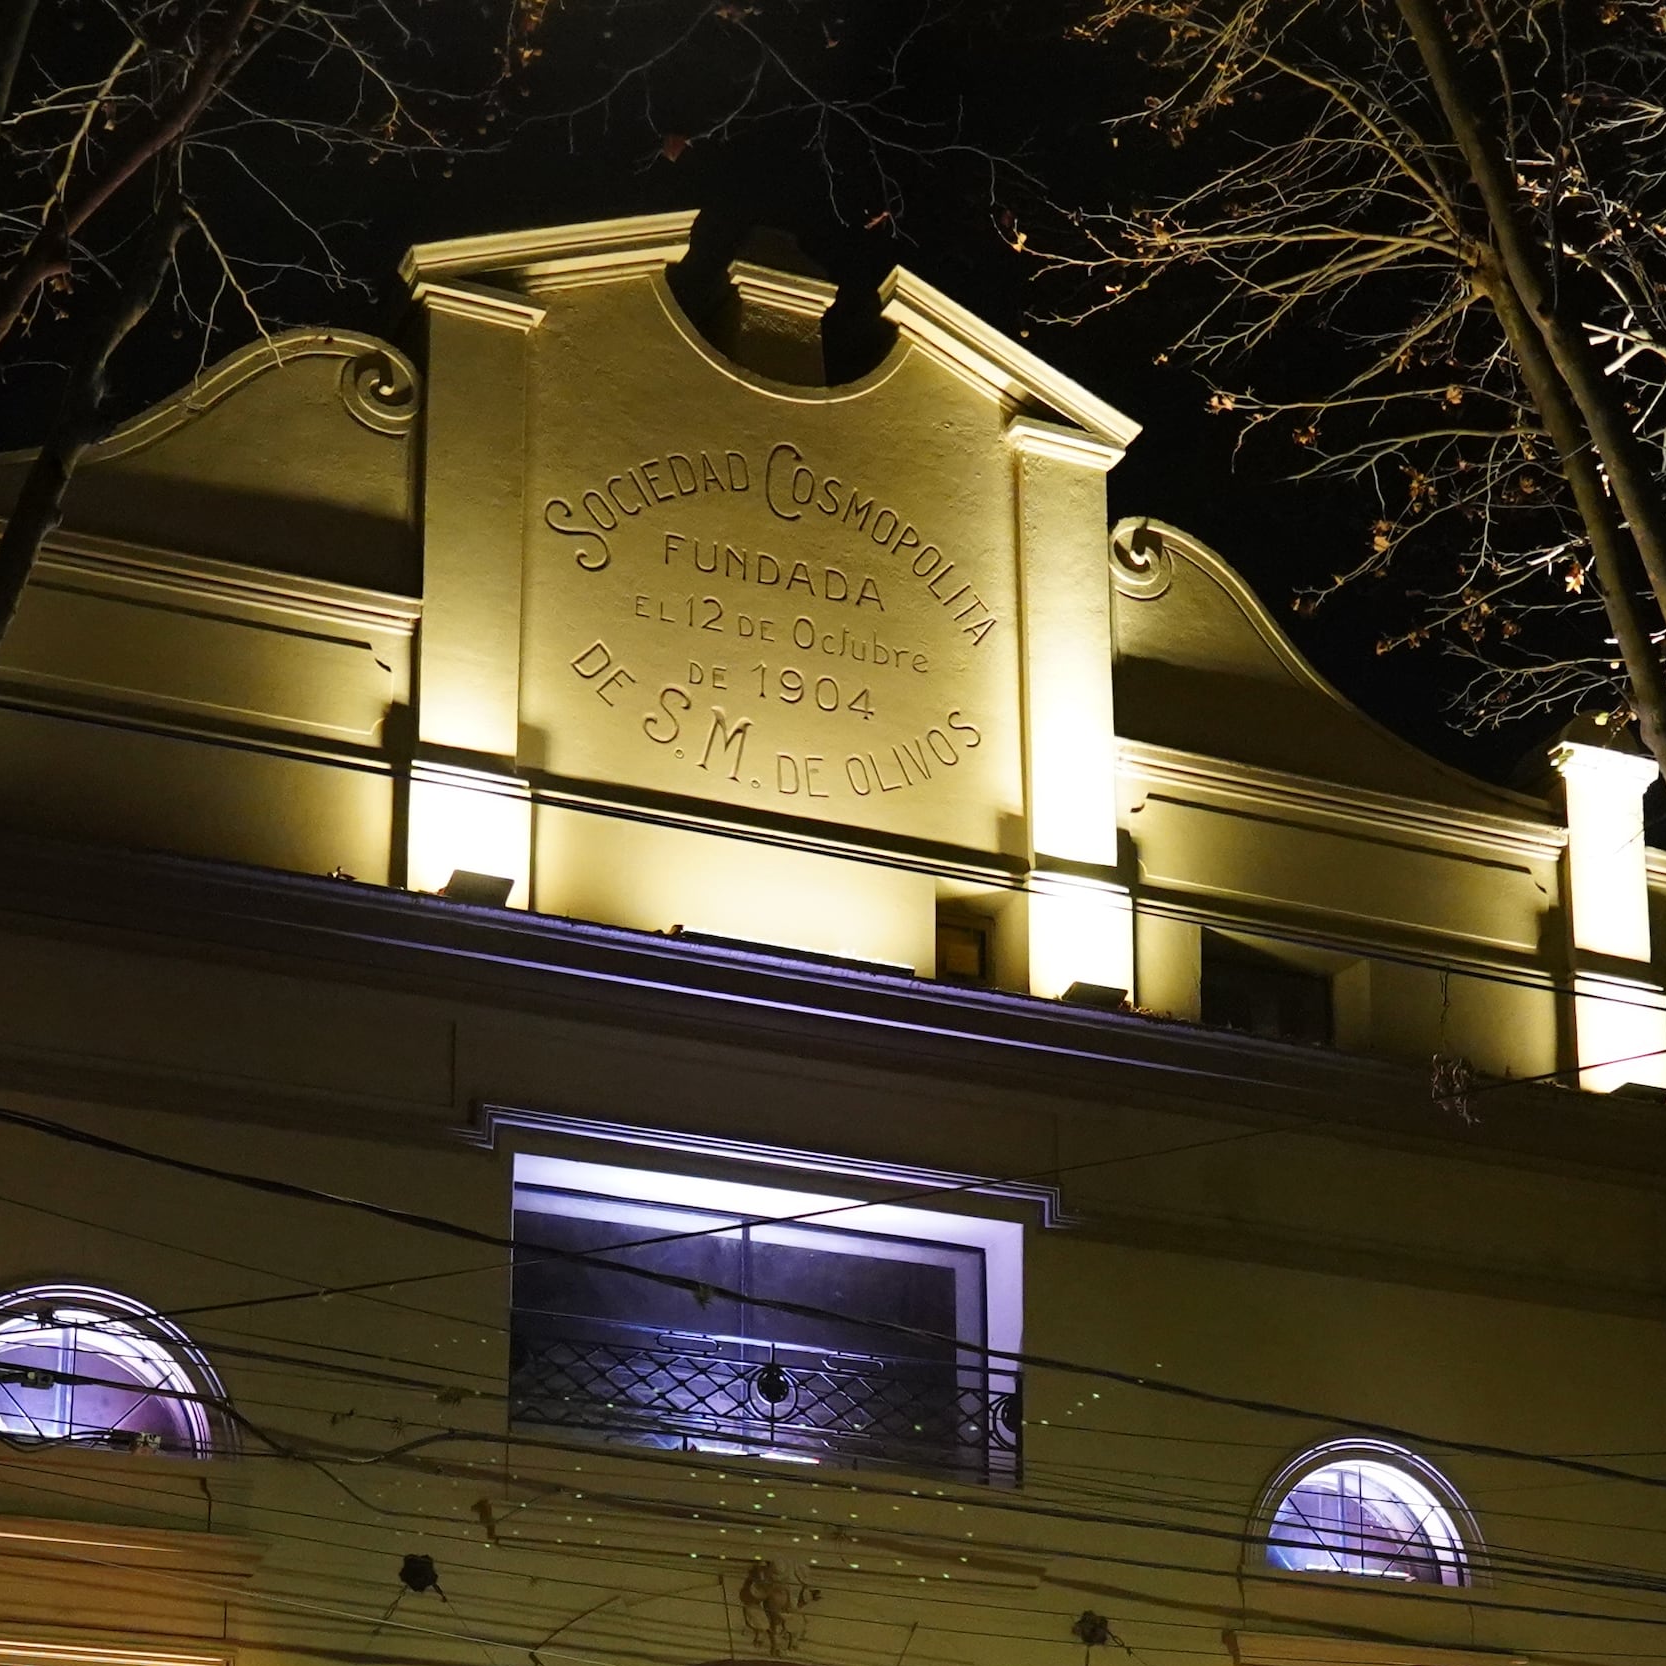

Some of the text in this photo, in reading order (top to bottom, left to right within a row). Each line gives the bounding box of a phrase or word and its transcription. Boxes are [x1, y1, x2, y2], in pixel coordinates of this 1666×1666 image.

[544, 441, 997, 646] SOCIEDAD COSMOPOLITA
[664, 531, 885, 612] FUNDADA
[636, 593, 675, 624] EL
[686, 594, 724, 632] 12
[738, 612, 775, 642] DE
[570, 639, 637, 707] DE
[777, 752, 830, 798] DE
[845, 708, 982, 797] OLIVOS
[688, 659, 875, 721] DE 1904
